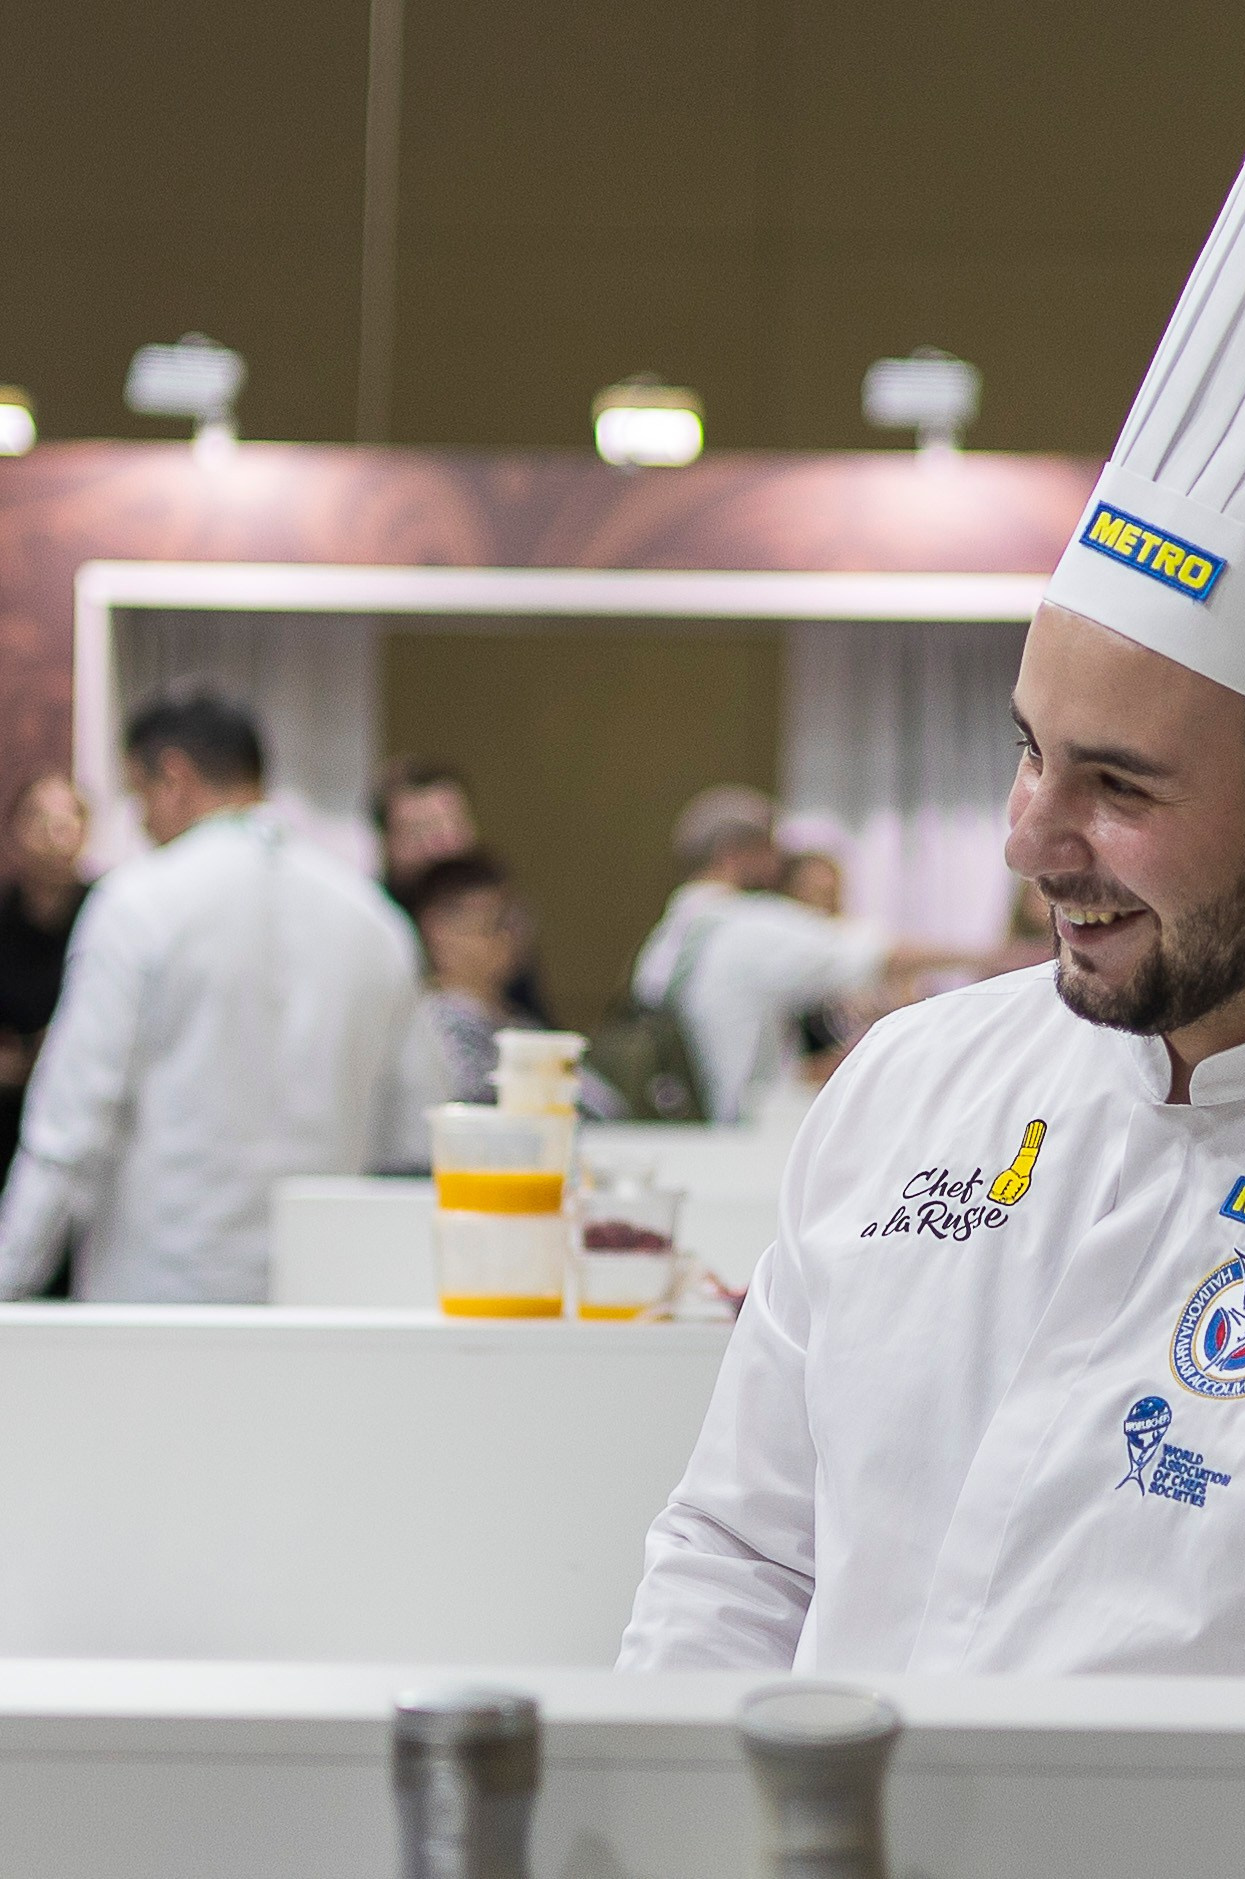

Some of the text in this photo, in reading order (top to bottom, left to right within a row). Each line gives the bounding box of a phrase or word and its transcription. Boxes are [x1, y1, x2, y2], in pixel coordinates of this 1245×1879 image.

[1089, 511, 1212, 588] METRO
[902, 1167, 983, 1204] Chef
[860, 1200, 1009, 1242] a la Russe
[1176, 1267, 1233, 1378] НАЦИОНАЛЬНАЯ
[1163, 1443, 1204, 1465] WORLD
[1152, 1469, 1208, 1496] OF CHEFS
[1157, 1456, 1232, 1487] ASSOCIATION
[1148, 1481, 1206, 1508] SOCIETIES
